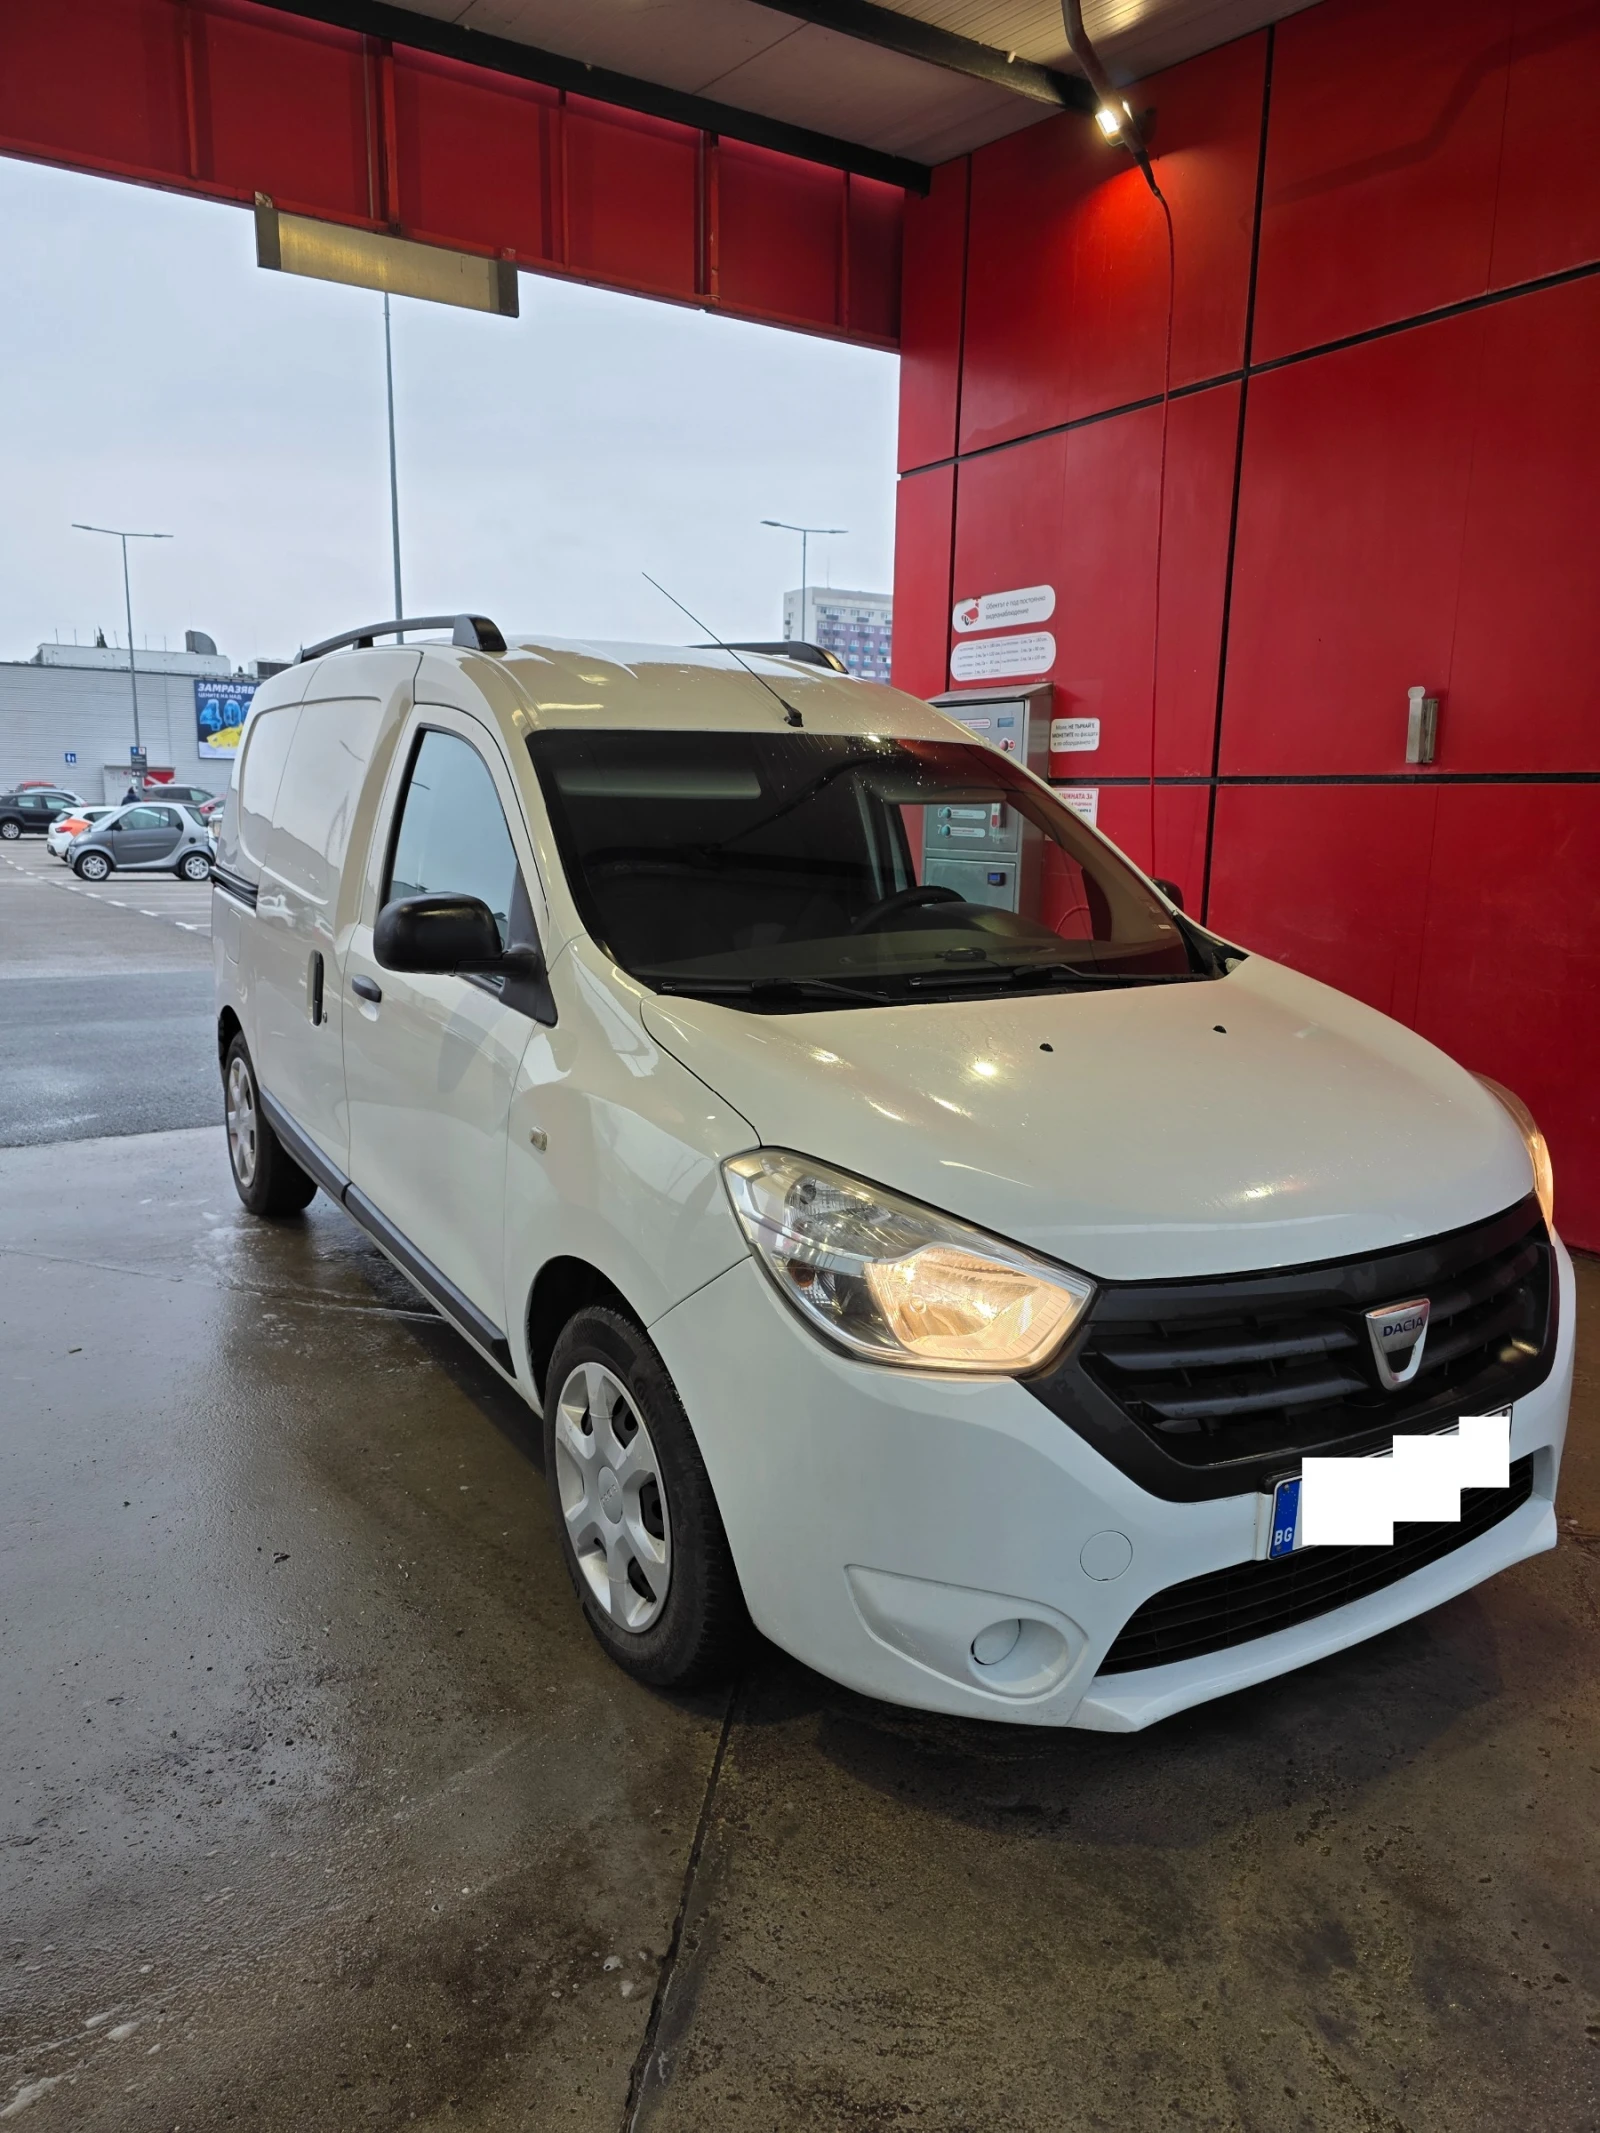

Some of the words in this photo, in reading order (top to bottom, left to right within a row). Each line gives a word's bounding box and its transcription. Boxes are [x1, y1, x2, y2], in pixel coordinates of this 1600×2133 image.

[937, 825, 942, 834] 7
[1383, 1317, 1424, 1337] DACIA
[1274, 1526, 1293, 1546] BG
